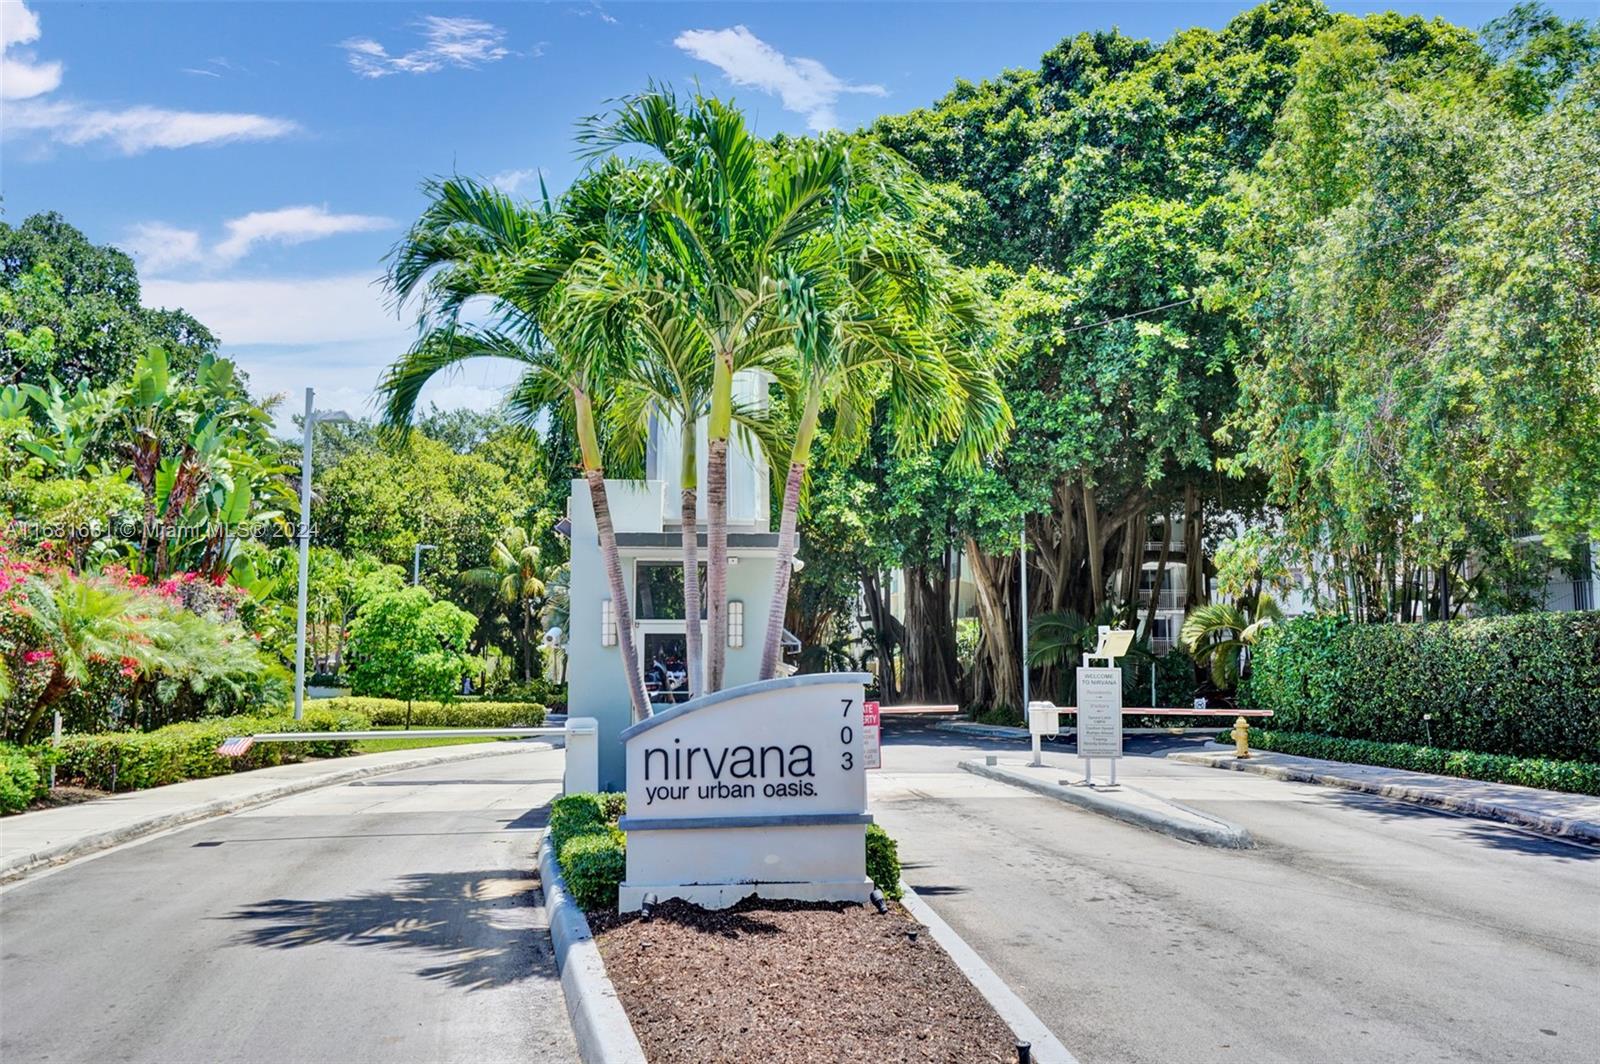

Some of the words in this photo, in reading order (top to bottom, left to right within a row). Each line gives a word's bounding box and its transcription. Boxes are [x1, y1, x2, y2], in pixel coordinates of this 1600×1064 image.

[644, 738, 815, 780] nirvana
[645, 785, 689, 805] your
[698, 781, 754, 799] urban
[763, 780, 818, 798] oasis.
